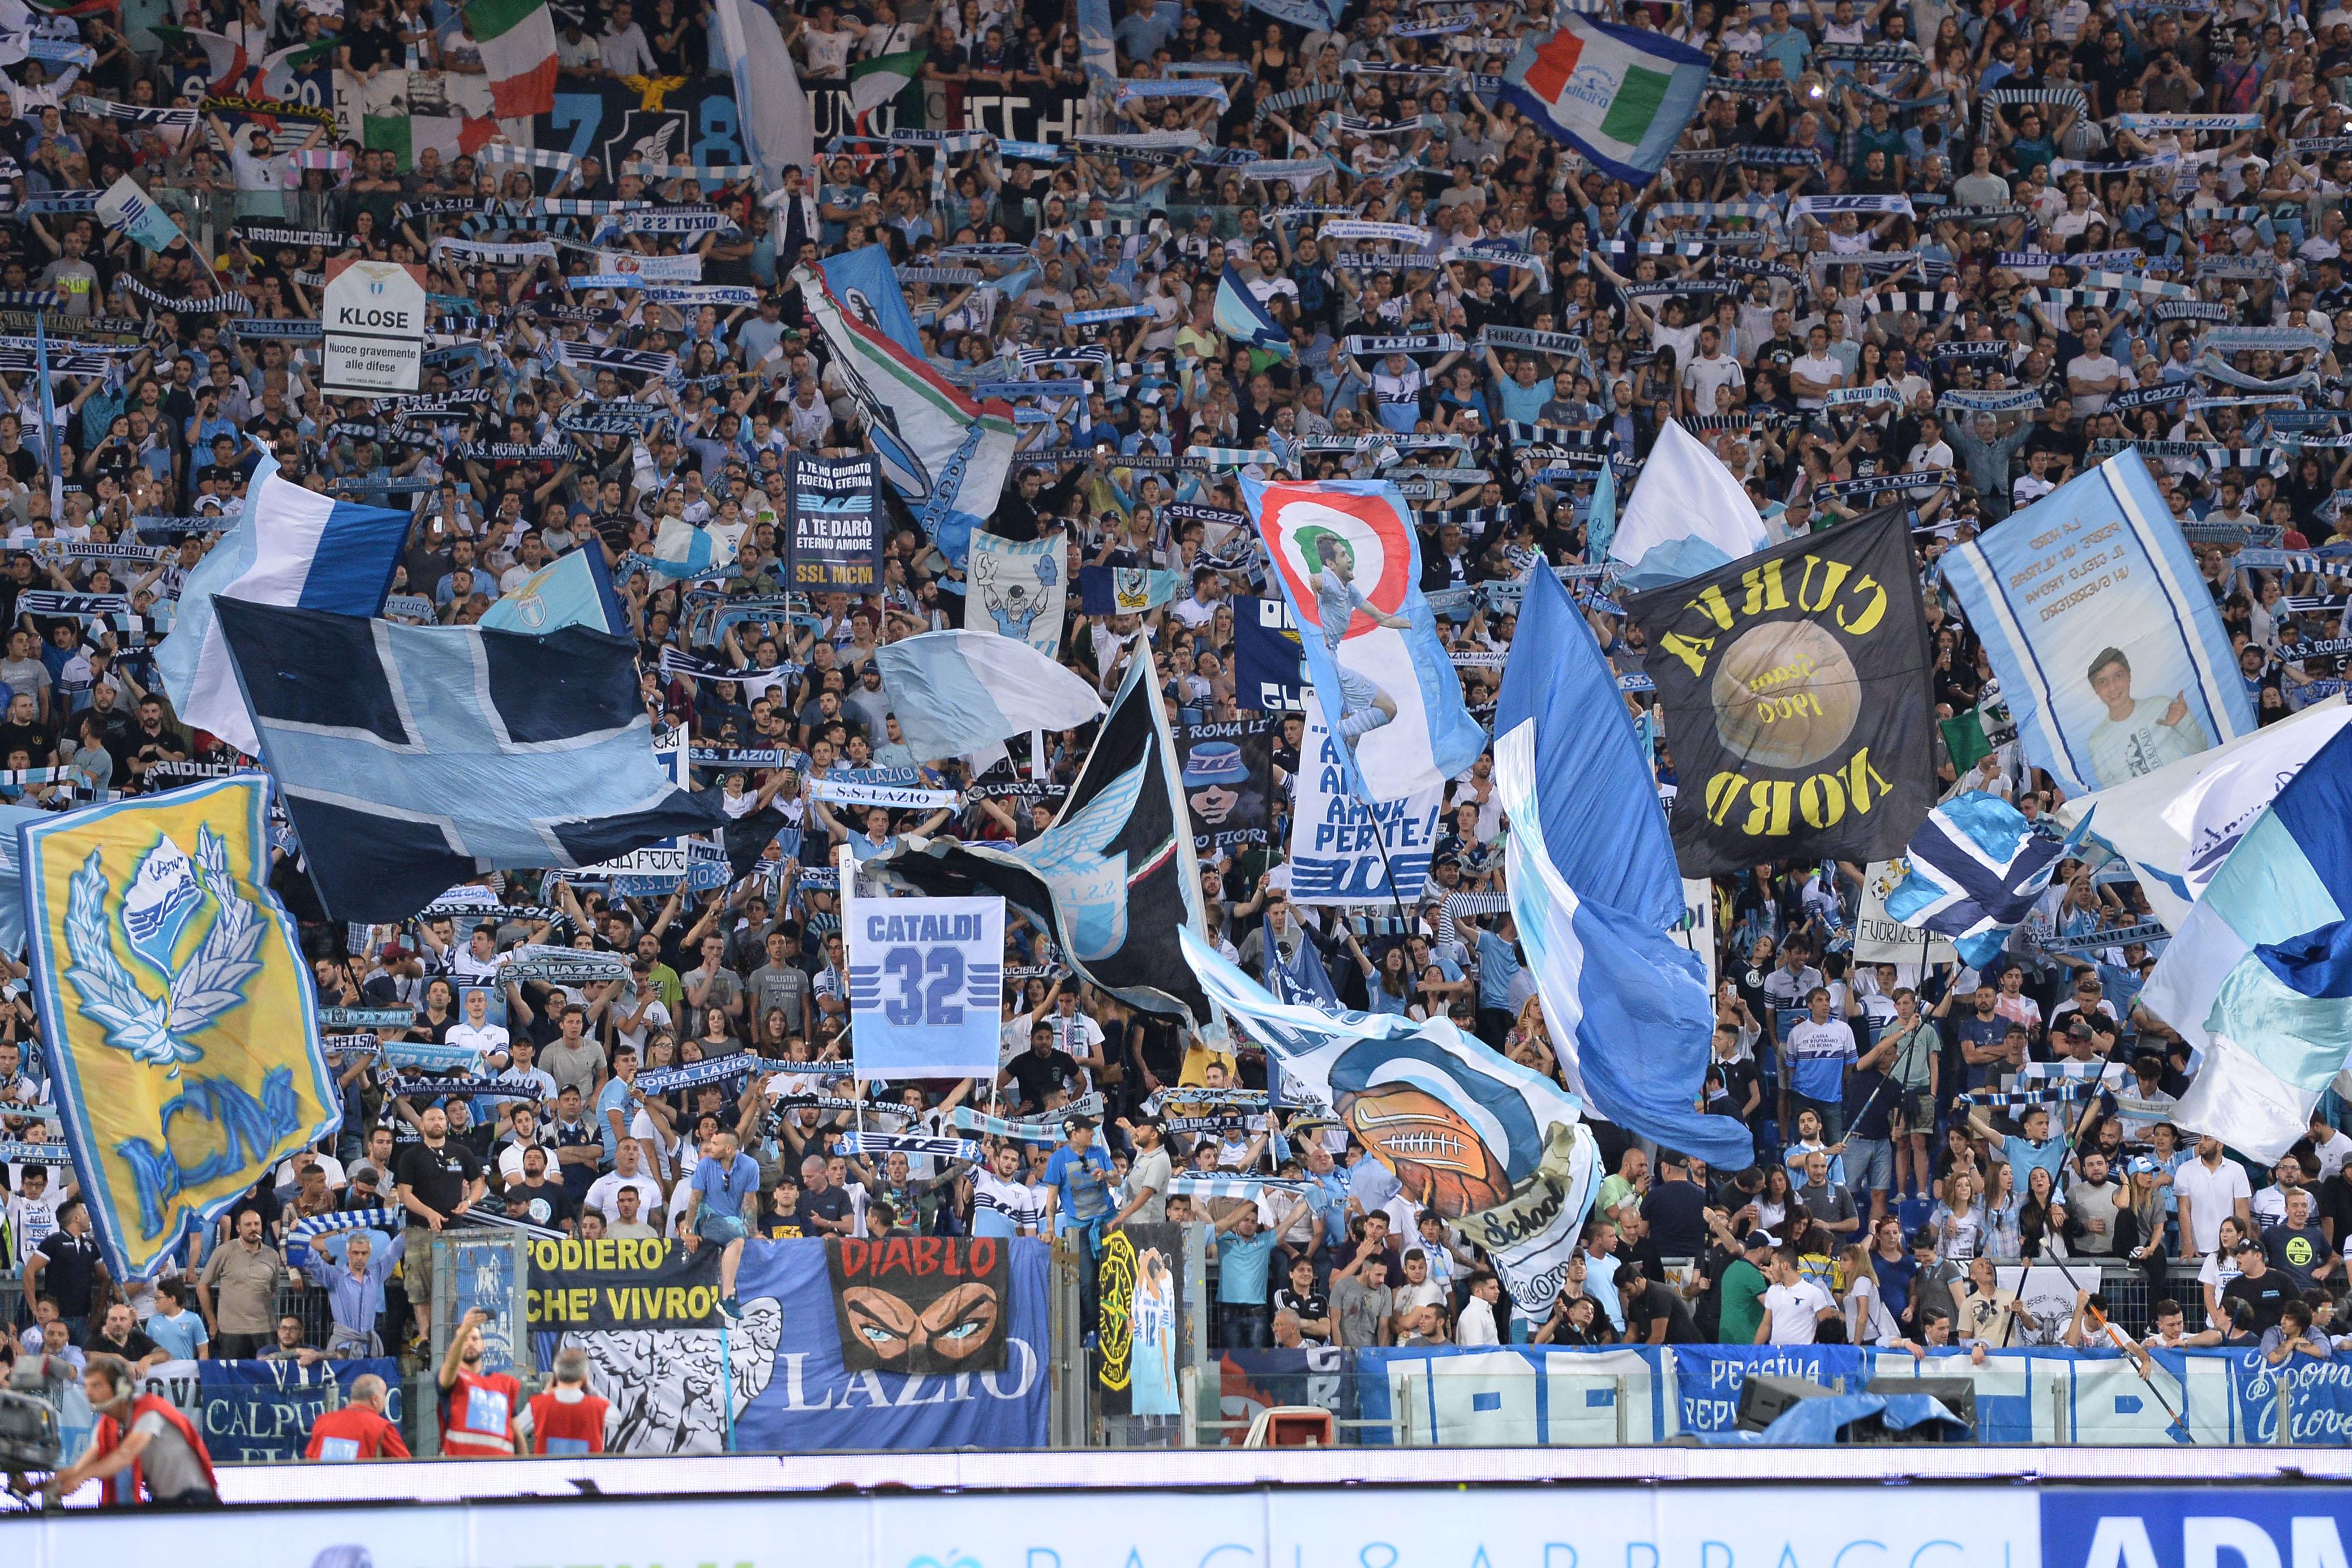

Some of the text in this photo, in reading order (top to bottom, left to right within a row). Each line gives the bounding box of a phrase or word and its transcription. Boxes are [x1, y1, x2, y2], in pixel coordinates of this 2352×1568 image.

[2183, 118, 2236, 127] LAZIO
[552, 93, 742, 190] 7 8
[2000, 252, 2059, 265] LIBERA
[340, 307, 409, 329] KLOSE
[551, 303, 603, 317] lazio
[1374, 337, 1427, 349] LAZIO
[1487, 329, 1580, 352] FORZA LAZIO
[329, 342, 416, 360] Nuoce gravemente
[346, 359, 396, 373] alle difese
[439, 389, 490, 403] LAZIO
[2143, 383, 2186, 401] cazzi
[2160, 443, 2203, 454] MERDA
[798, 461, 871, 476] A TE HO GIURATO
[836, 474, 872, 488] ETERNA
[1849, 474, 1928, 492] S.S. LAZIO
[1196, 508, 1244, 525] cazzi
[797, 517, 872, 536] A TE DARÒ
[67, 543, 156, 558] IRRIDUCIBILI
[797, 536, 872, 550] ETERNO AMORE
[796, 565, 873, 583] SSL MCM
[1189, 722, 1243, 739] ROMA
[689, 748, 775, 761] S.S. LAZIO
[833, 767, 915, 783] S.S. LAZIO
[836, 787, 930, 804] S.S. LAZIO
[986, 783, 1065, 795] CURVA 12
[1215, 829, 1268, 848] FIORI
[633, 875, 661, 891] S.S.
[867, 914, 982, 942] CATALDI
[2069, 930, 2124, 948] AVANTI
[501, 963, 625, 977] S.S. LAZIO
[765, 975, 797, 983] HOLLISTER
[884, 946, 965, 1026] 32
[683, 1058, 718, 1069] ROMANISTI
[720, 1054, 737, 1062] MAI
[637, 1059, 750, 1089] FORZA LAZIO
[668, 1081, 693, 1090] MAGICA
[694, 1076, 718, 1085] LAZIO
[818, 1097, 869, 1110] MOLTO
[527, 1238, 672, 1271] 'ODIERO'
[841, 1237, 996, 1278] DIABLO
[606, 1286, 718, 1321] VIVRO'
